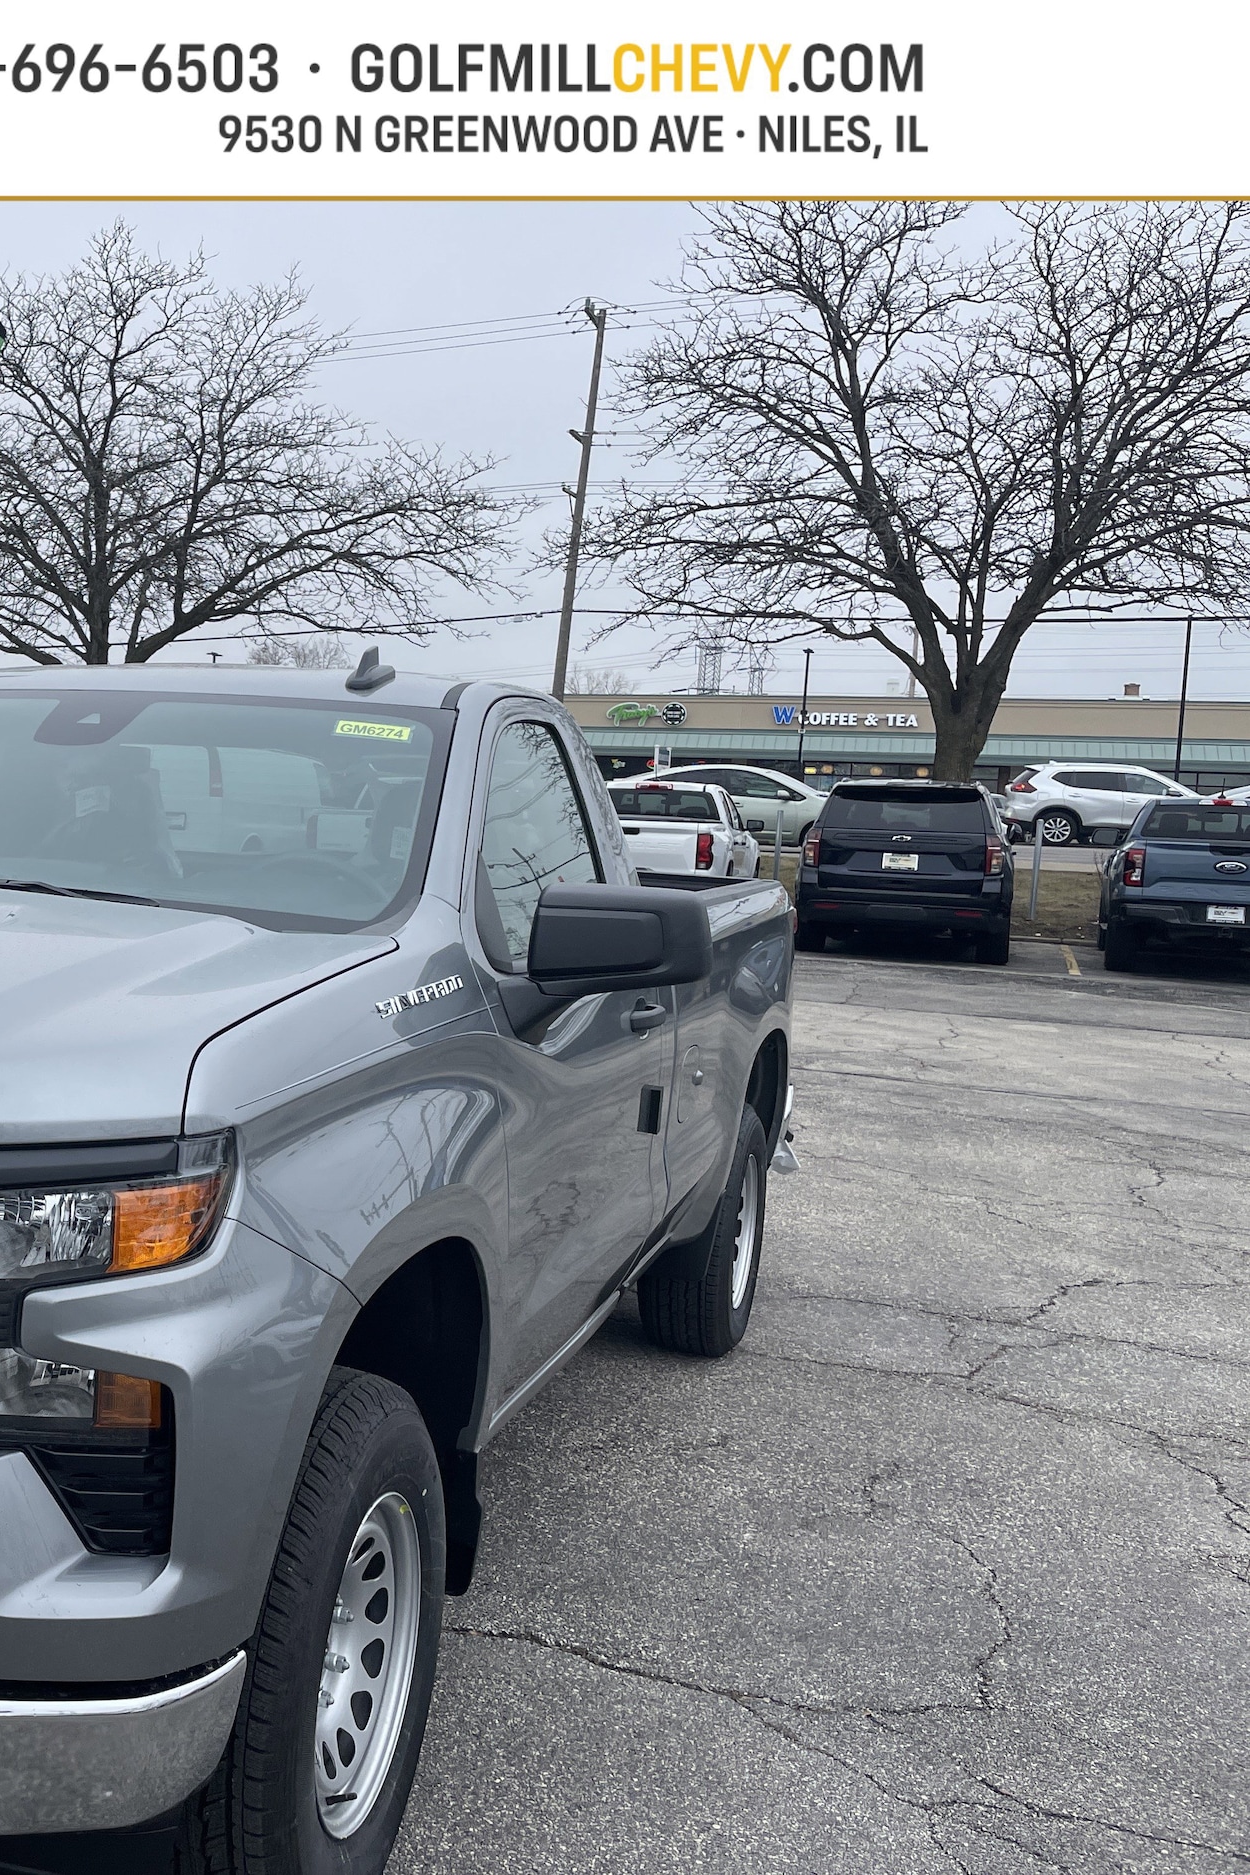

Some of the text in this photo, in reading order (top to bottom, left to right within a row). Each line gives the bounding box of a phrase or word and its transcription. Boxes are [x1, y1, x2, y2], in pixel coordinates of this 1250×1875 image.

[773, 705, 918, 727] W COFFEE & TEA
[340, 723, 404, 739] GM6274
[375, 974, 464, 1019] SILVERADO
